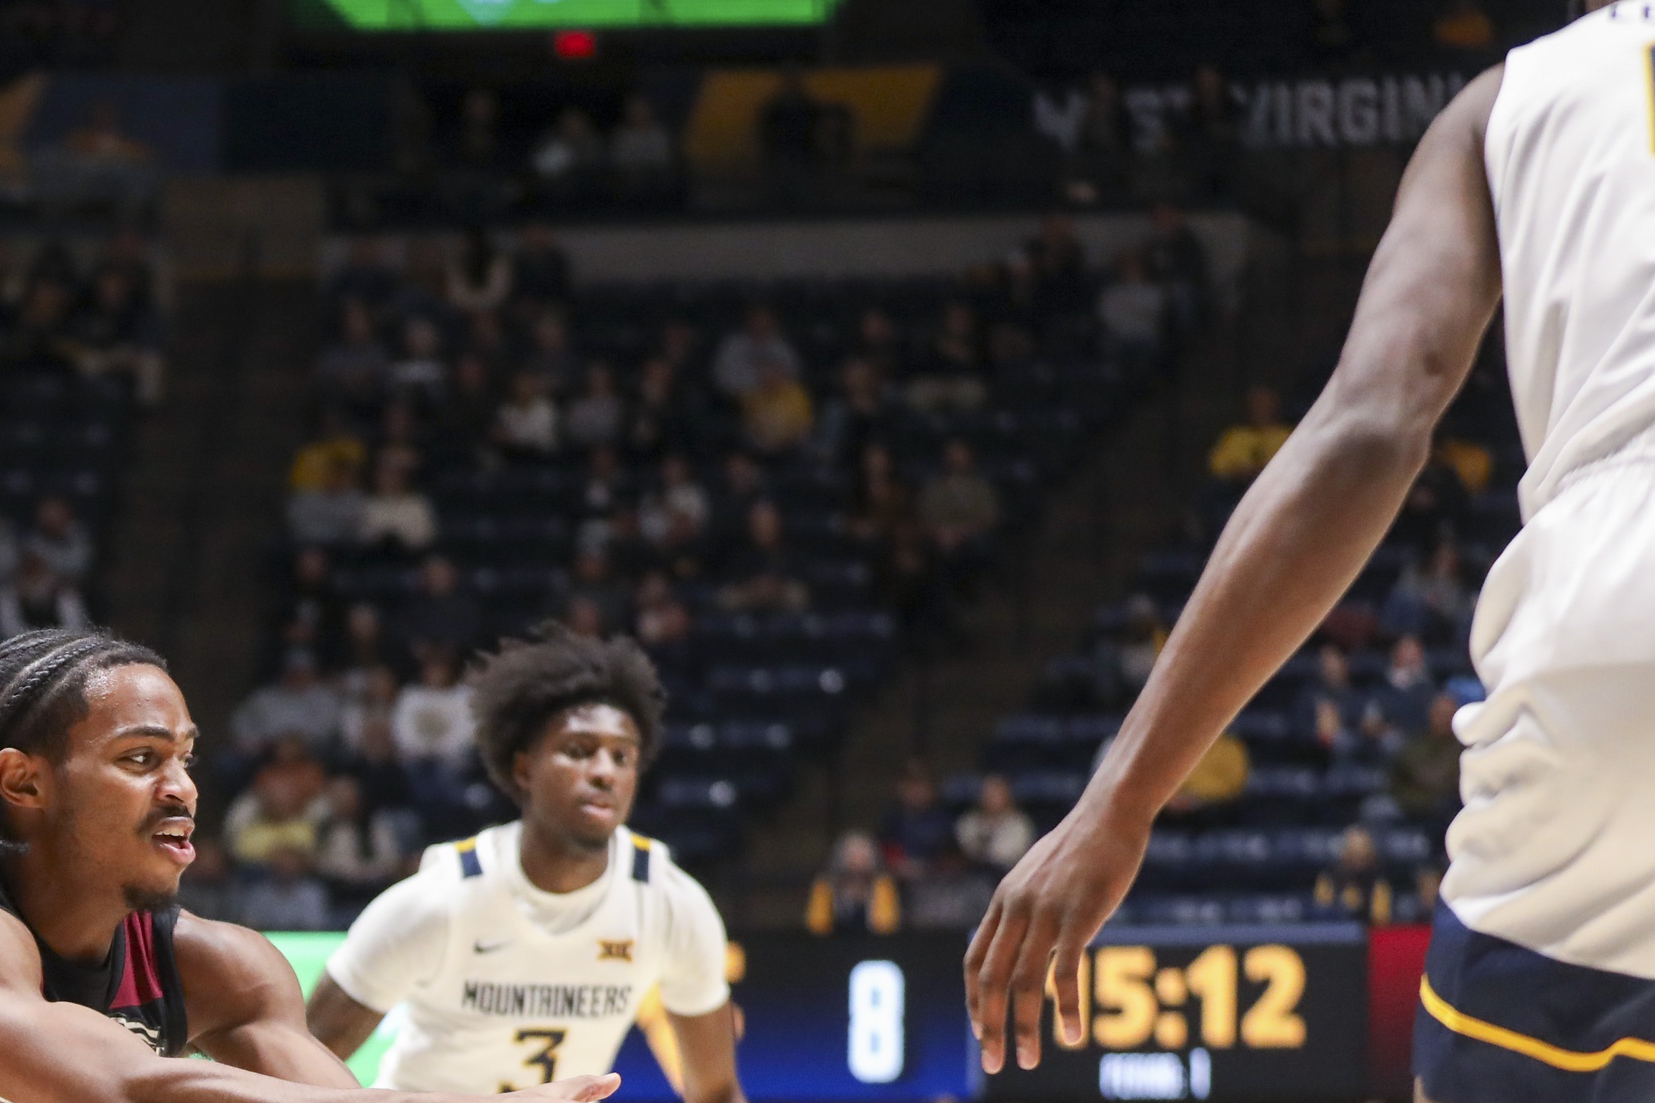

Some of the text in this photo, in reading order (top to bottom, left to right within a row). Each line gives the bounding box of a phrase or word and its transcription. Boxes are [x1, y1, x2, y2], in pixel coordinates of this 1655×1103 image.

[1228, 70, 1464, 148] VIRGIN
[462, 980, 632, 1019] MOUNTAINEERS
[848, 959, 905, 1083] 8
[498, 1026, 568, 1095] 3
